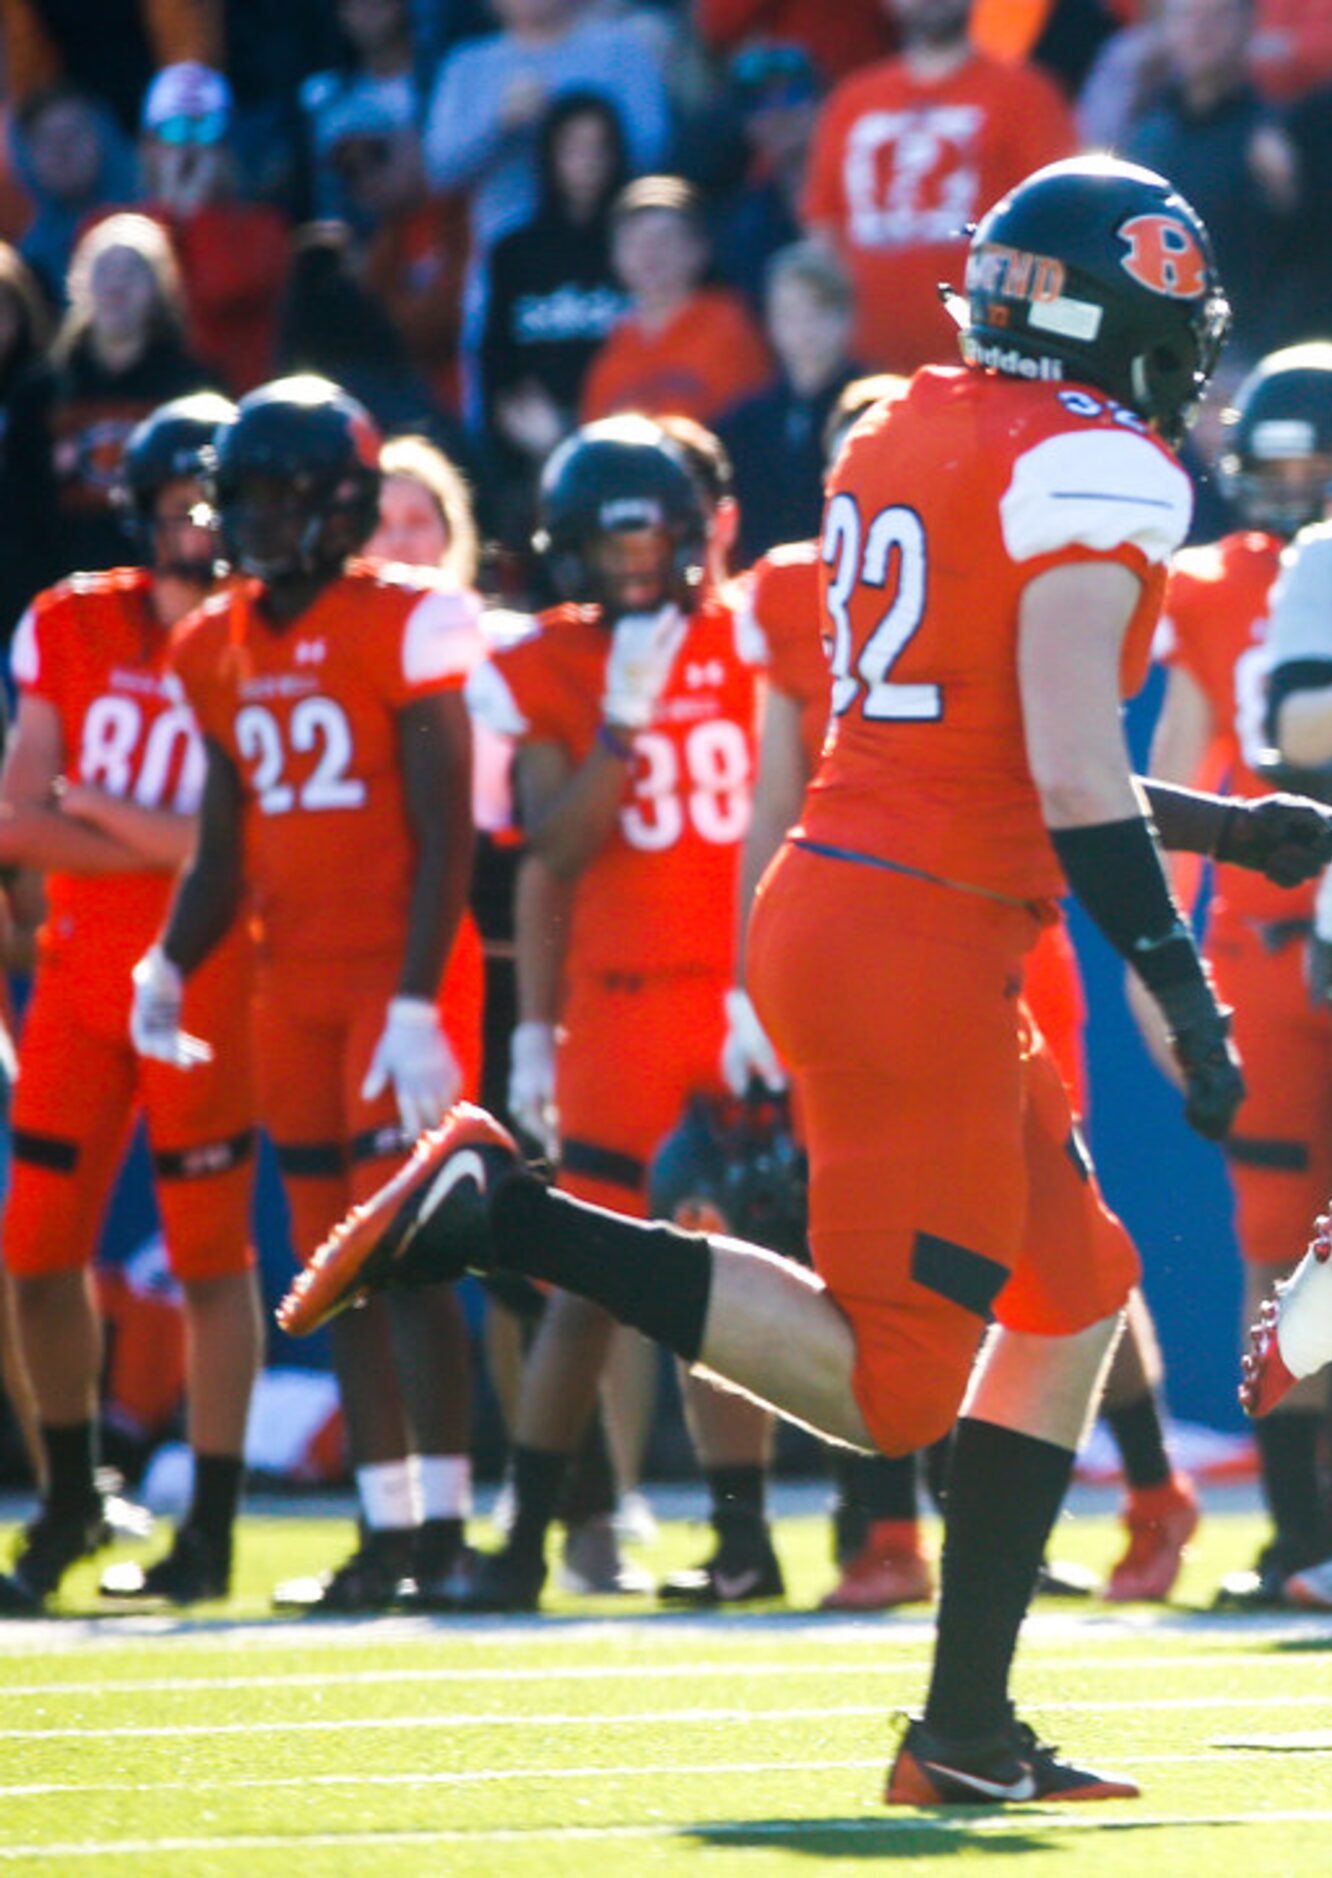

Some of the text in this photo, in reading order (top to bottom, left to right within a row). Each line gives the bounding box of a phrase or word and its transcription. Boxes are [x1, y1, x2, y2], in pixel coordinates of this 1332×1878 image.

[821, 492, 943, 722] 32
[234, 696, 368, 816] 22
[620, 718, 752, 852] 38
